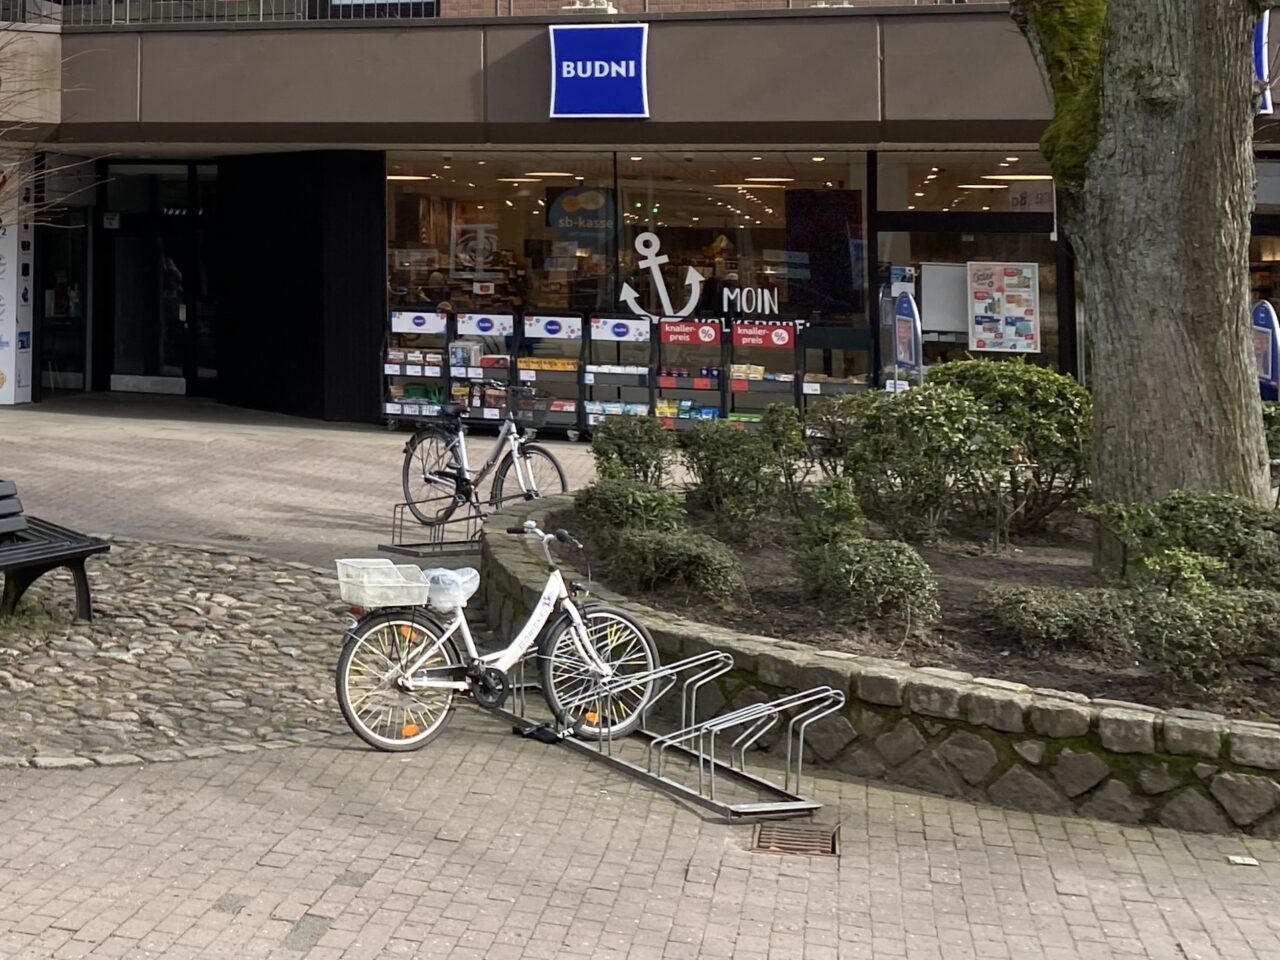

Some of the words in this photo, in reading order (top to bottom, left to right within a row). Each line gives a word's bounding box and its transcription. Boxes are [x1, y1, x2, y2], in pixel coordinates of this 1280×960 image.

[562, 60, 636, 78] BUDNI
[558, 215, 614, 228] sb-kasse
[722, 287, 780, 315] MOIN
[665, 324, 697, 333] knaller-
[737, 326, 770, 336] knaller-
[669, 334, 691, 343] preis
[742, 336, 764, 346] preis
